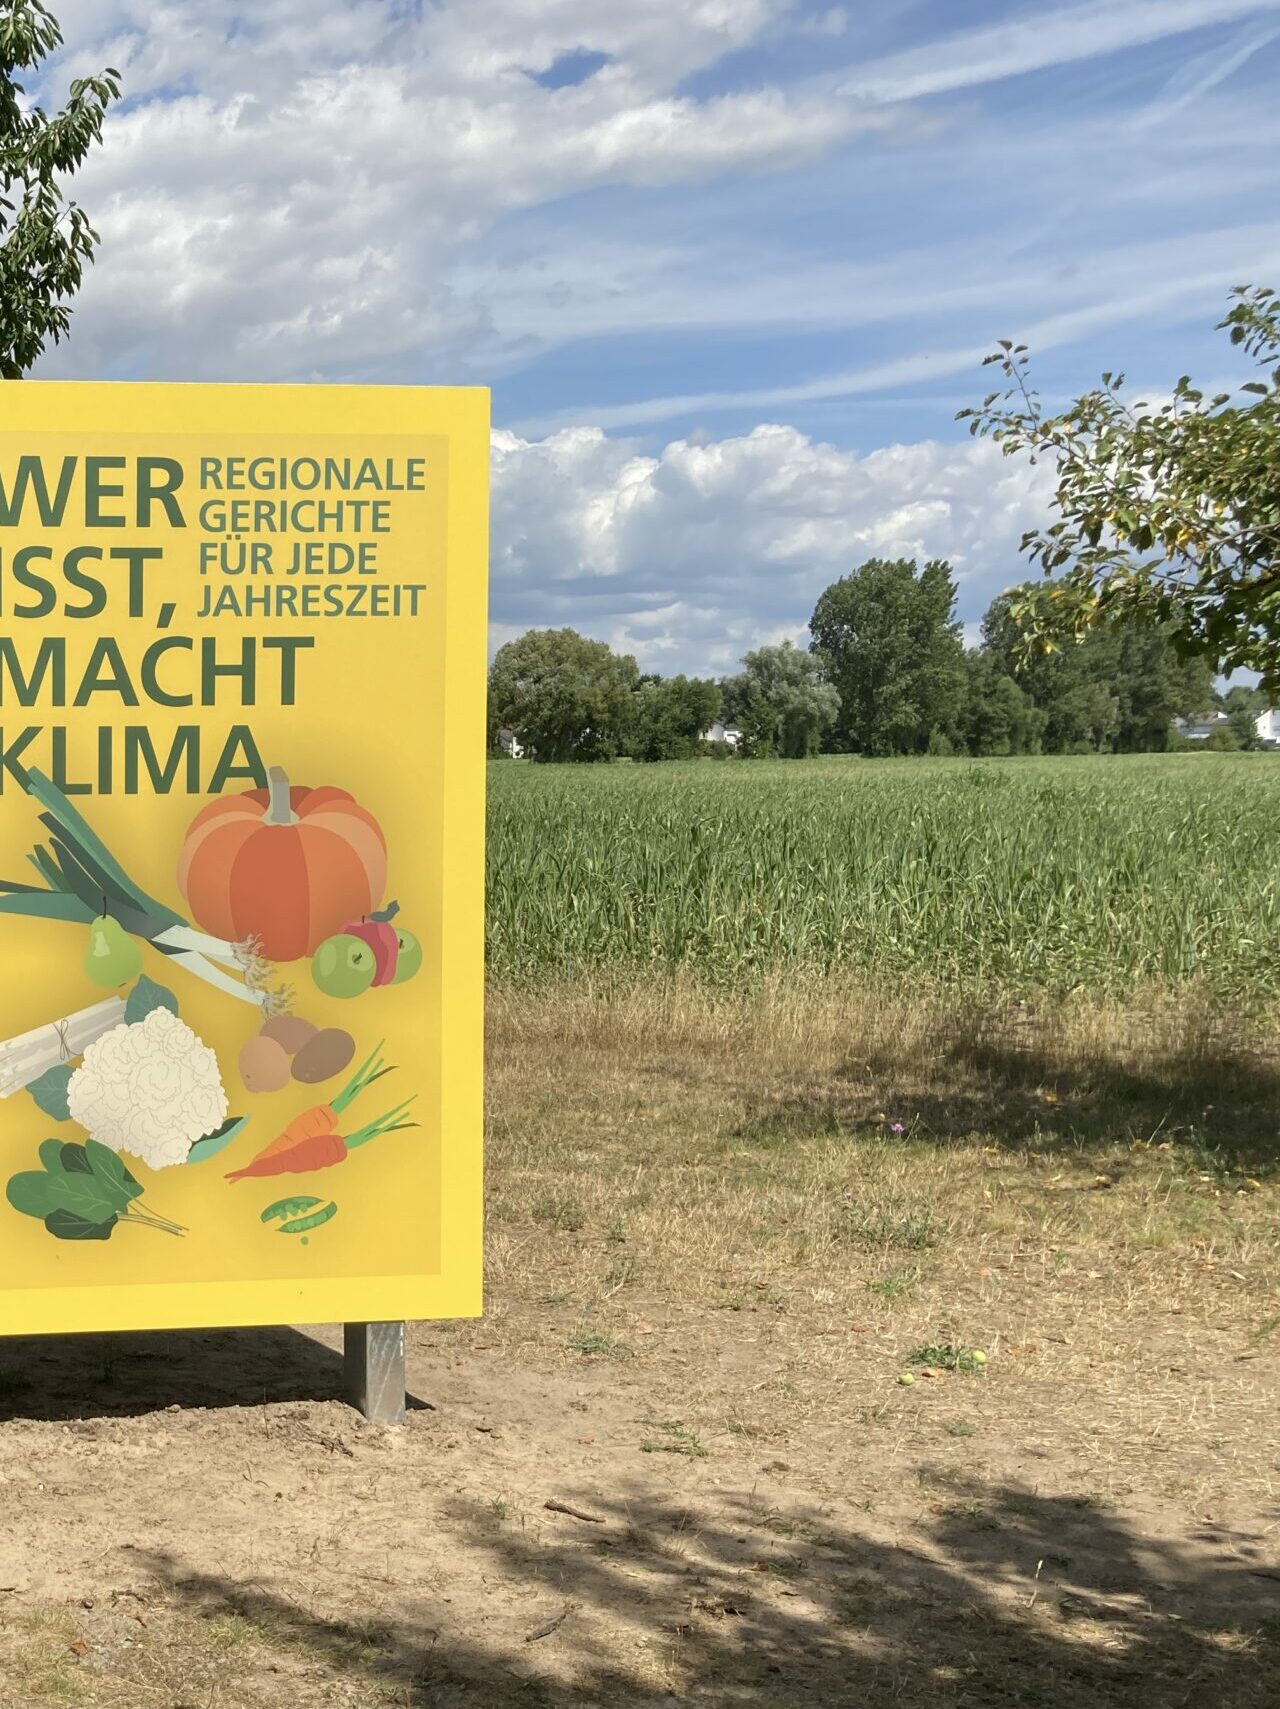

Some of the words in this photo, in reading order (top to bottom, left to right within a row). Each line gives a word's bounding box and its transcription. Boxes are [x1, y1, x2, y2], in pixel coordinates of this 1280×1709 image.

[199, 457, 426, 491] REGIONALE
[199, 500, 391, 533] GERICHTE
[199, 534, 274, 575] FÜR
[285, 542, 377, 576] JEDE
[197, 584, 427, 617] JAHRESZEIT
